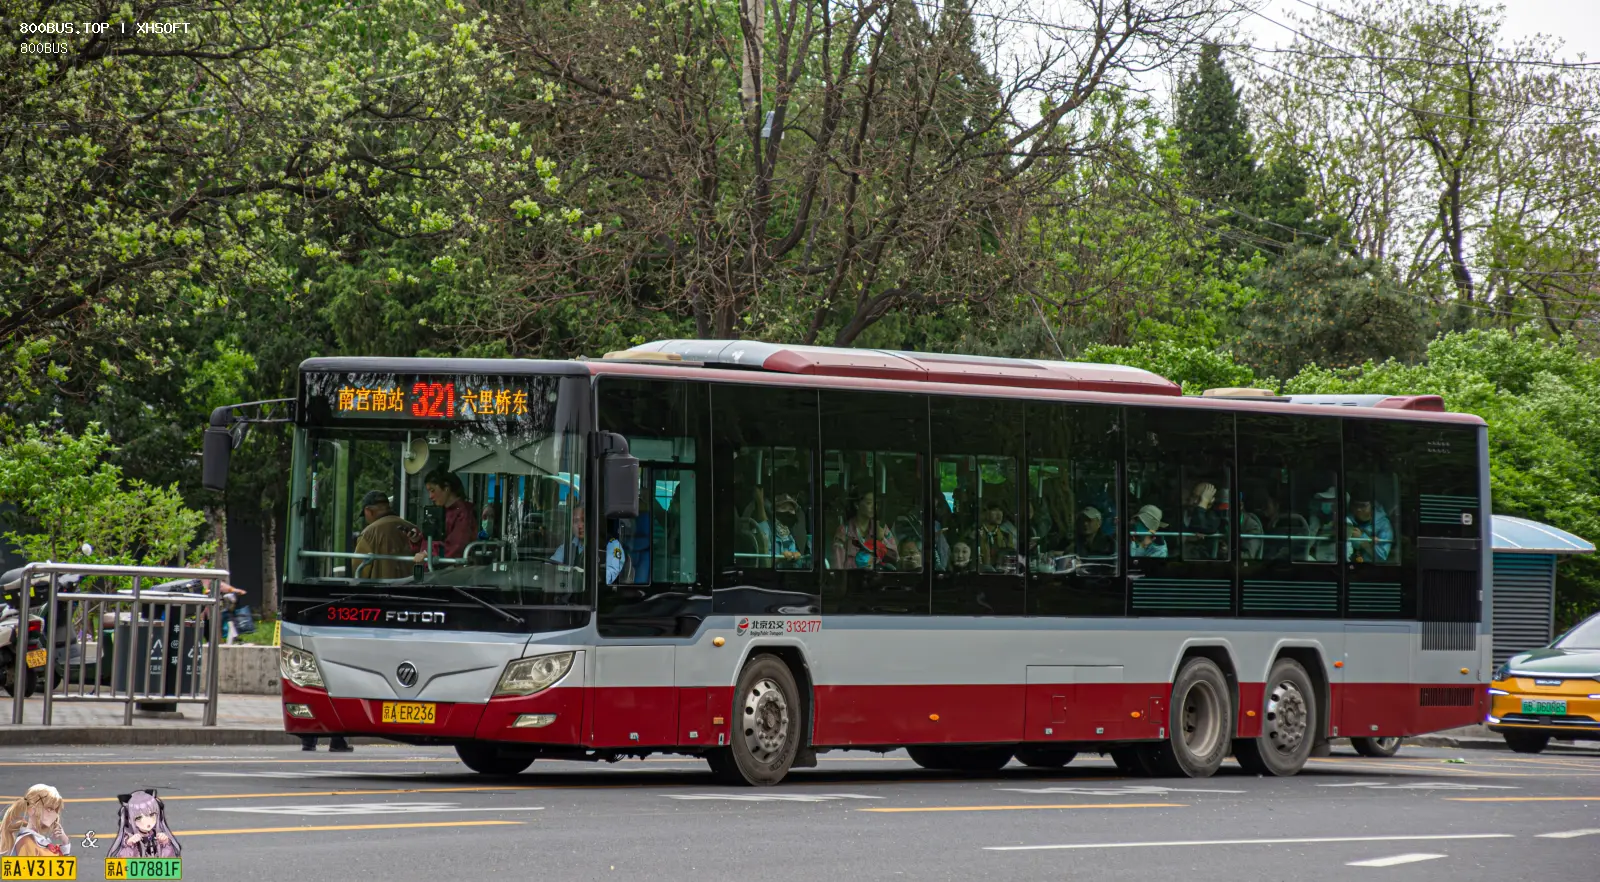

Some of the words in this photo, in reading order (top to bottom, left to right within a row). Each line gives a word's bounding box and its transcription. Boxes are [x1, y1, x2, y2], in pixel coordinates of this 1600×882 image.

[338, 385, 405, 412] 南宫南站
[411, 383, 454, 417] 321
[461, 388, 528, 416] 六里桥东
[327, 606, 381, 621] 3132177
[385, 611, 446, 624] FOTON
[751, 620, 784, 630] 北京公交
[786, 620, 822, 633] 3132177
